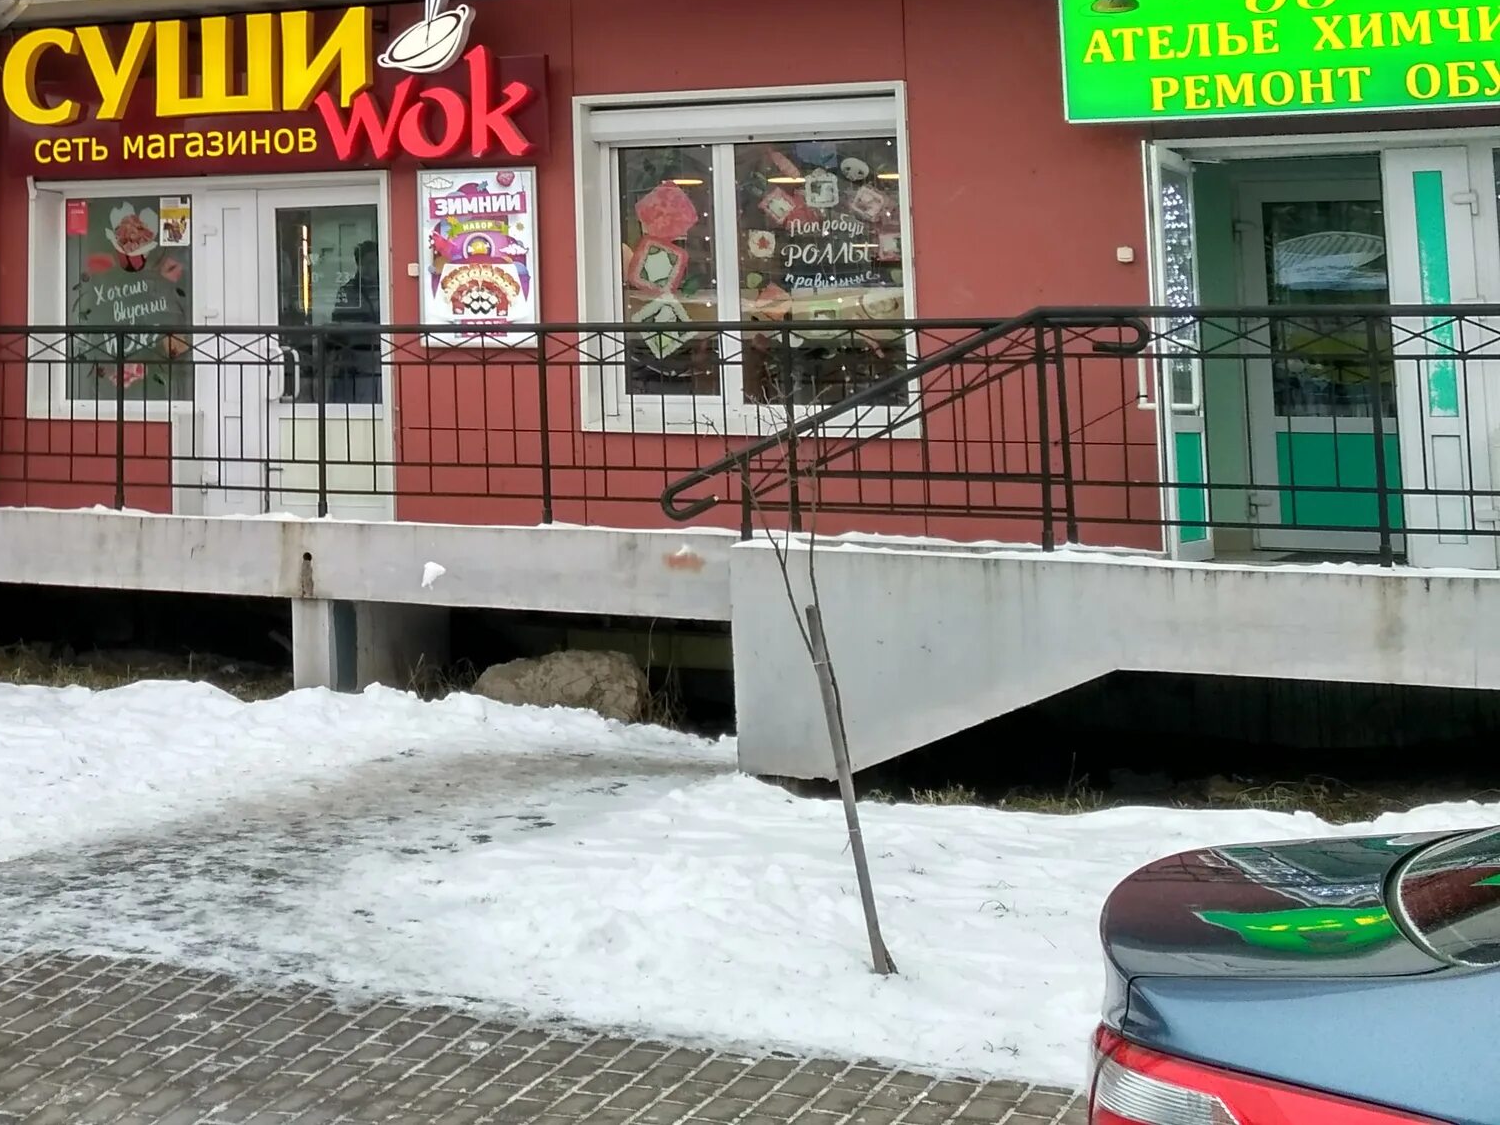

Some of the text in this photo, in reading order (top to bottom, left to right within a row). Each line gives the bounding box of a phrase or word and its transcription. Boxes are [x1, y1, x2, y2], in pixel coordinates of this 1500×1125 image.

[1083, 18, 1281, 64] АТЕЛЬЕ
[2, 6, 373, 126] СУШИ
[1150, 66, 1371, 112] РЕМОНТ
[34, 126, 318, 163] сеть магазинов
[434, 193, 521, 216] ЗИМНИЙ
[462, 222, 494, 231] НАБОР
